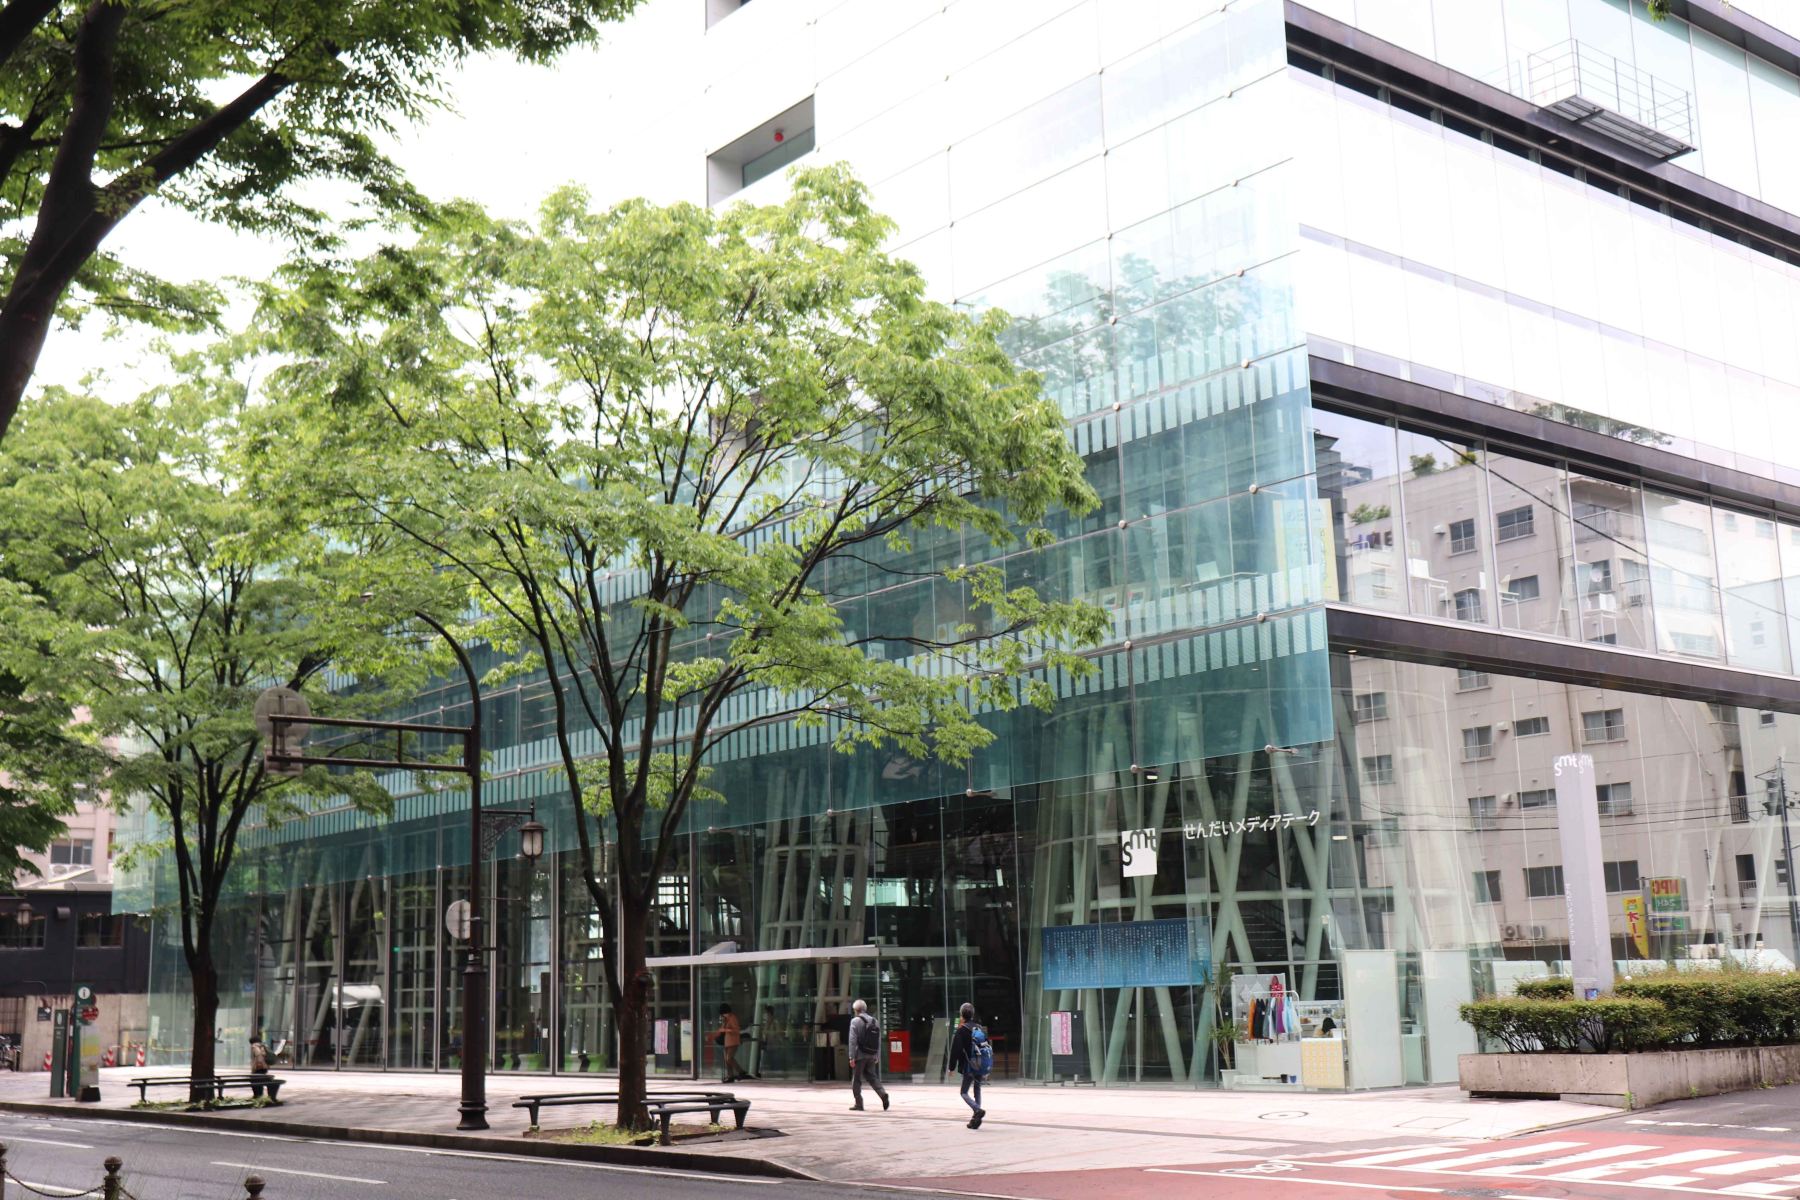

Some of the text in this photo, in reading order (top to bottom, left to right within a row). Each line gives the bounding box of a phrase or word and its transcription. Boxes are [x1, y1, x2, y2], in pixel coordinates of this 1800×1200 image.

[1183, 809, 1320, 840] せんだいメディアテーク
